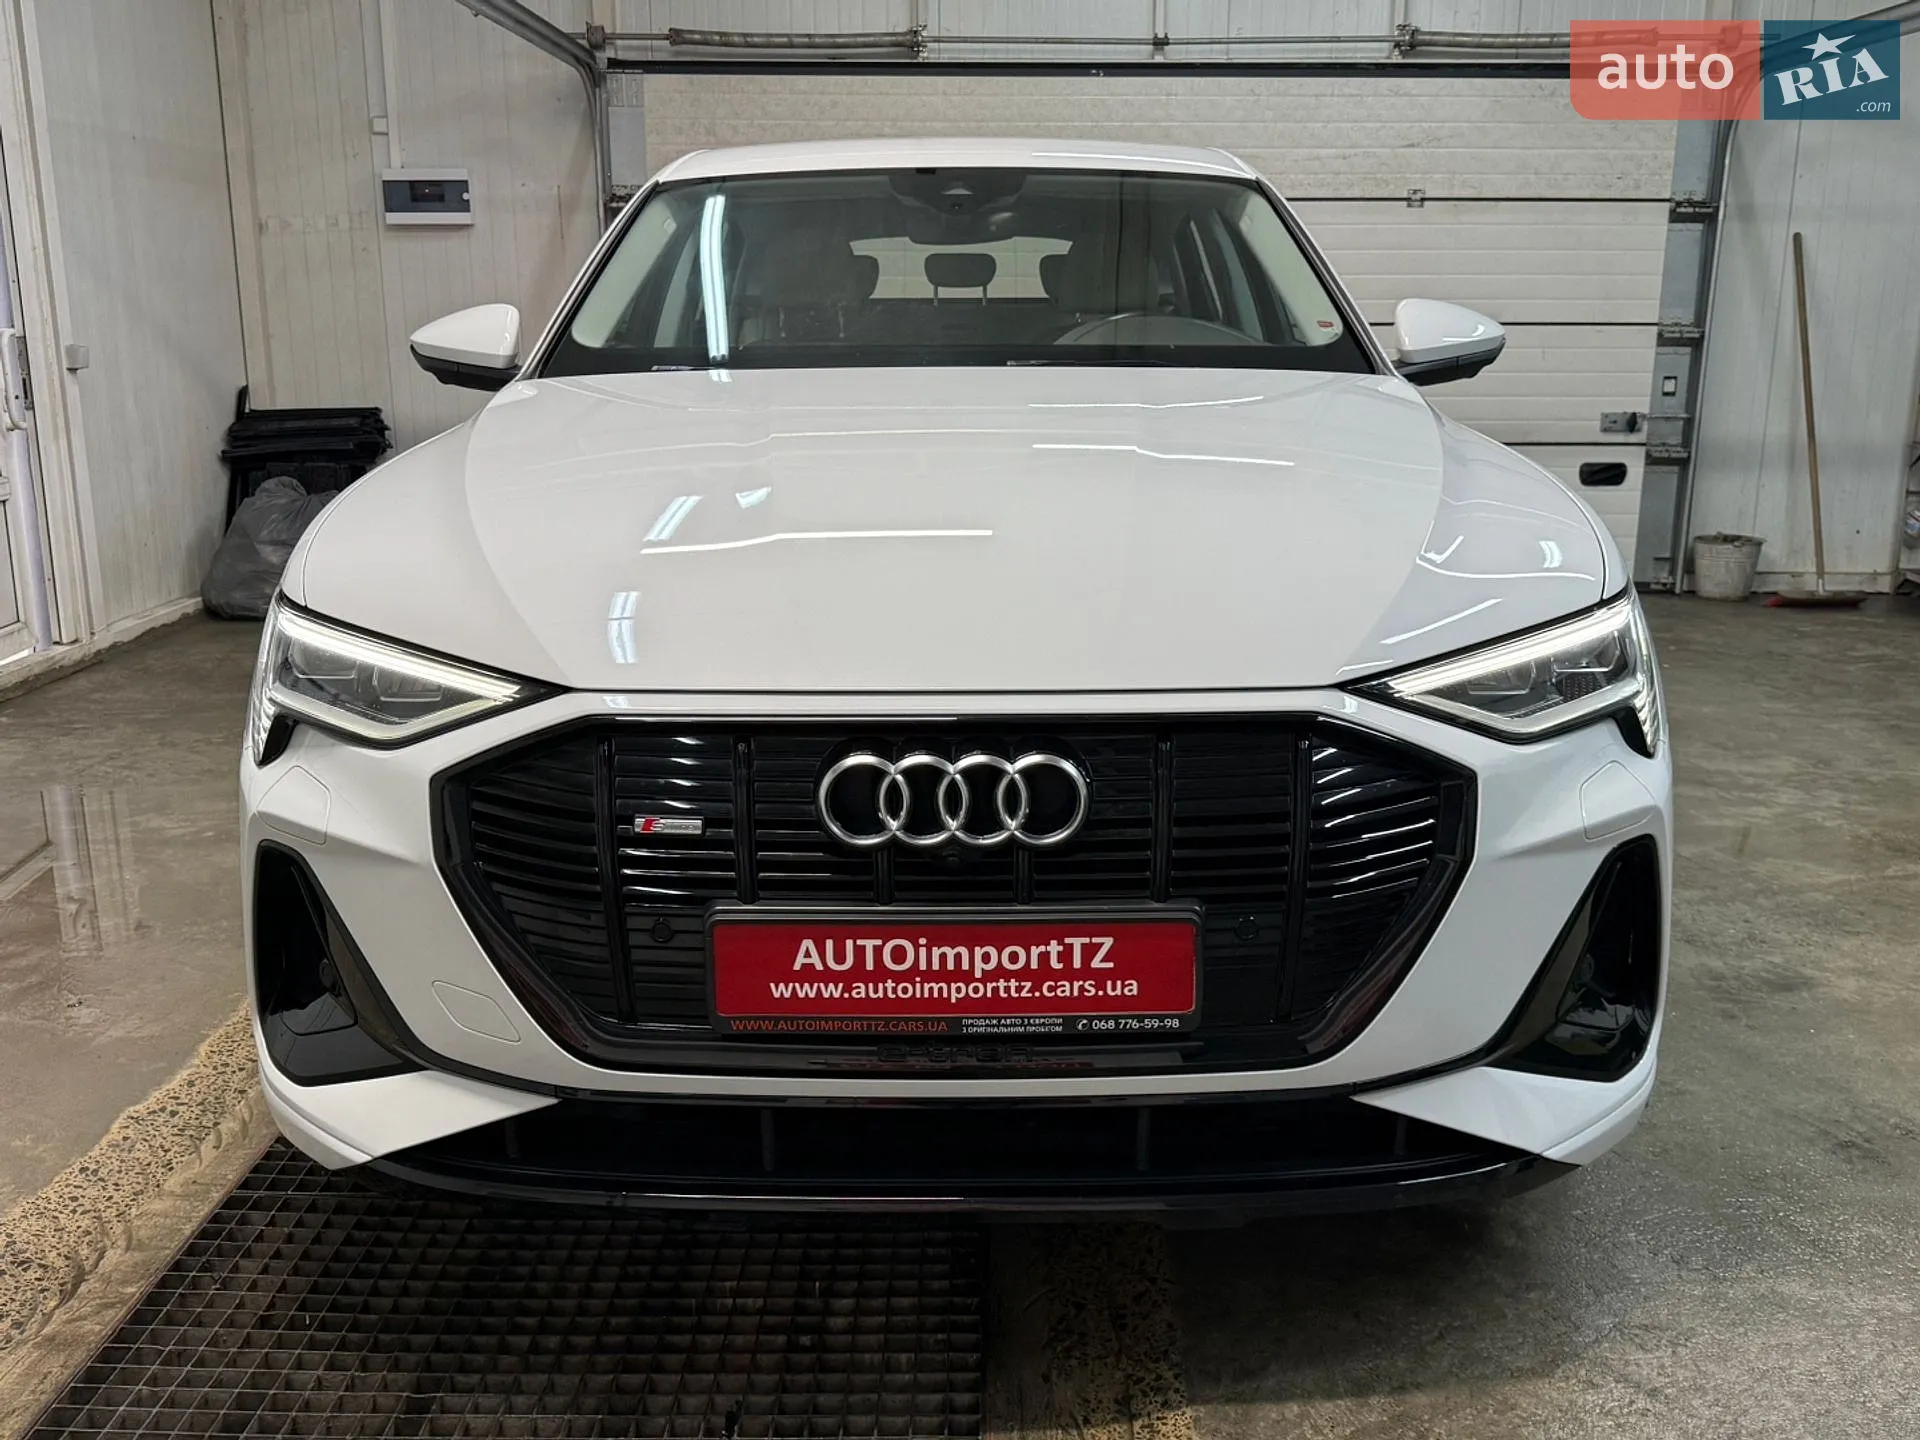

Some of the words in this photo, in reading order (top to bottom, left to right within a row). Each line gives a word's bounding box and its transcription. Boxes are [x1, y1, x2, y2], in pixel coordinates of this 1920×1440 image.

[793, 936, 1114, 978] AUTOimportTZ
[769, 977, 1138, 1003] www.autoimporttz.cars.ua
[731, 1019, 948, 1033] WWW.AUTOIMPORTTZ.CARS.UA
[1092, 1020, 1115, 1029] 068
[1119, 1018, 1180, 1029] 776-59-98
